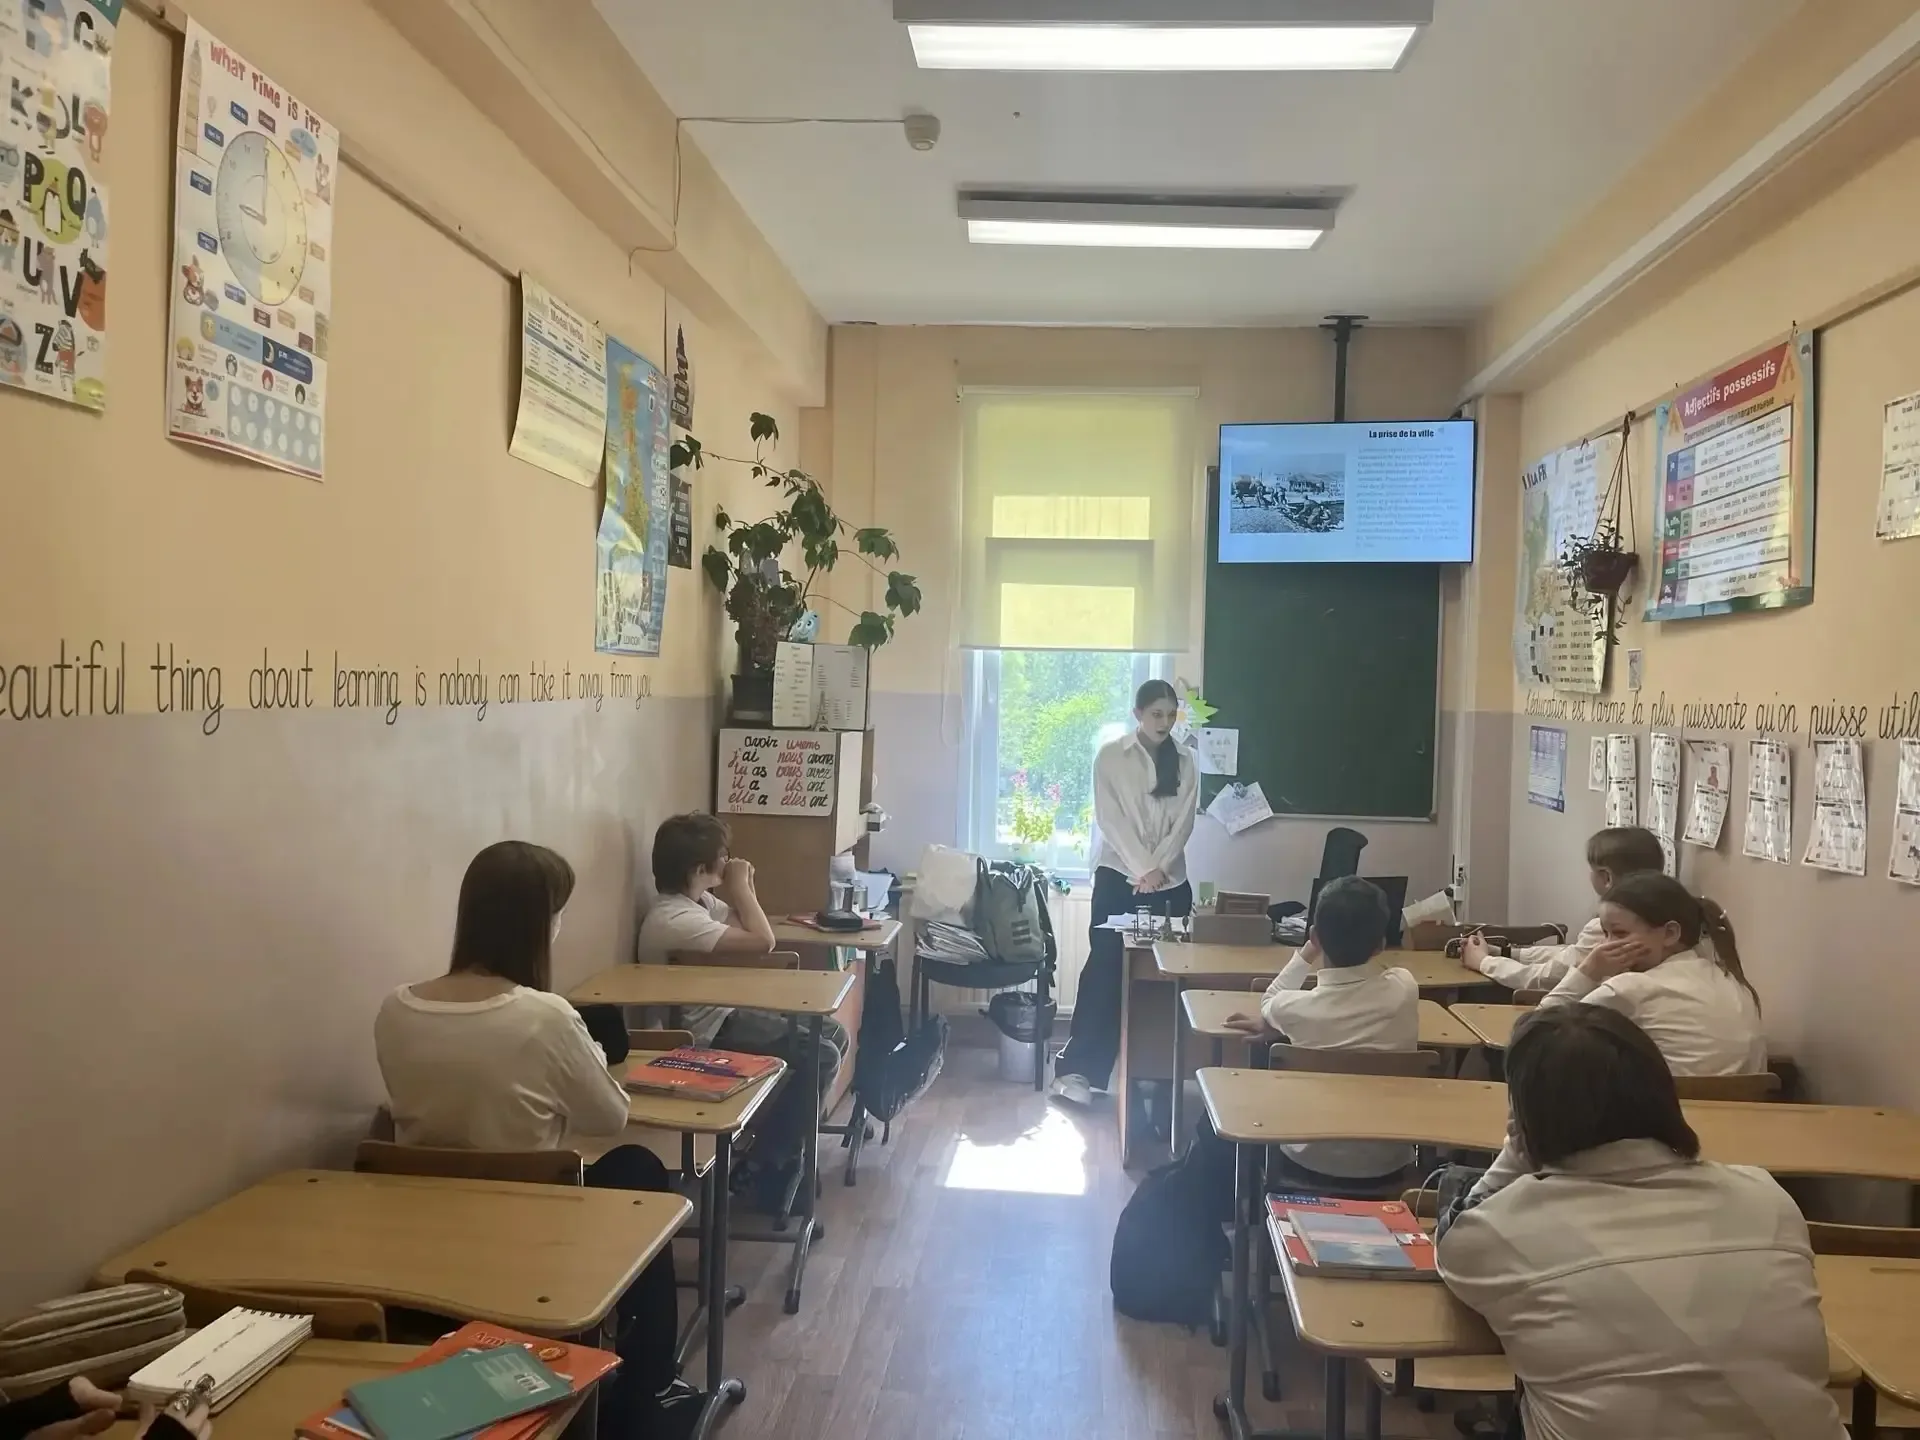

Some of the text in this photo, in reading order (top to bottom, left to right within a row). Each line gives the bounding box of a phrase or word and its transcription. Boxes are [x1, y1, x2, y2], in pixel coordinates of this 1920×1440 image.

[71, 91, 86, 137] L
[24, 151, 45, 204] P
[66, 167, 88, 221] Q
[23, 236, 44, 286] U
[59, 265, 84, 319] V
[34, 322, 55, 376] Z
[1684, 359, 1776, 417] Adjectifs possessifs
[1369, 430, 1377, 438] La
[1378, 430, 1398, 439] prise
[1399, 429, 1408, 438] de
[1418, 429, 1435, 438] ville
[150, 642, 224, 736] thing
[249, 646, 313, 709] about
[333, 649, 402, 726] learning
[415, 664, 427, 707] is
[439, 657, 488, 722] nobody
[498, 671, 520, 705] can
[529, 660, 556, 703] take
[562, 659, 571, 701] it
[578, 672, 604, 713] away
[610, 661, 633, 699] from
[636, 672, 653, 713] you
[744, 735, 778, 749] avoir
[1631, 690, 1644, 725] la
[1649, 690, 1676, 732] plus
[1680, 691, 1748, 742] puissante
[1807, 698, 1868, 748] puisse
[734, 762, 748, 776] tu
[752, 766, 767, 778] as
[806, 767, 832, 779] avez
[777, 751, 804, 765] nous
[728, 790, 756, 804] elle
[757, 793, 768, 806] a
[780, 791, 807, 807] elles
[732, 775, 745, 790] il
[749, 780, 760, 791] a
[784, 778, 803, 792] ils
